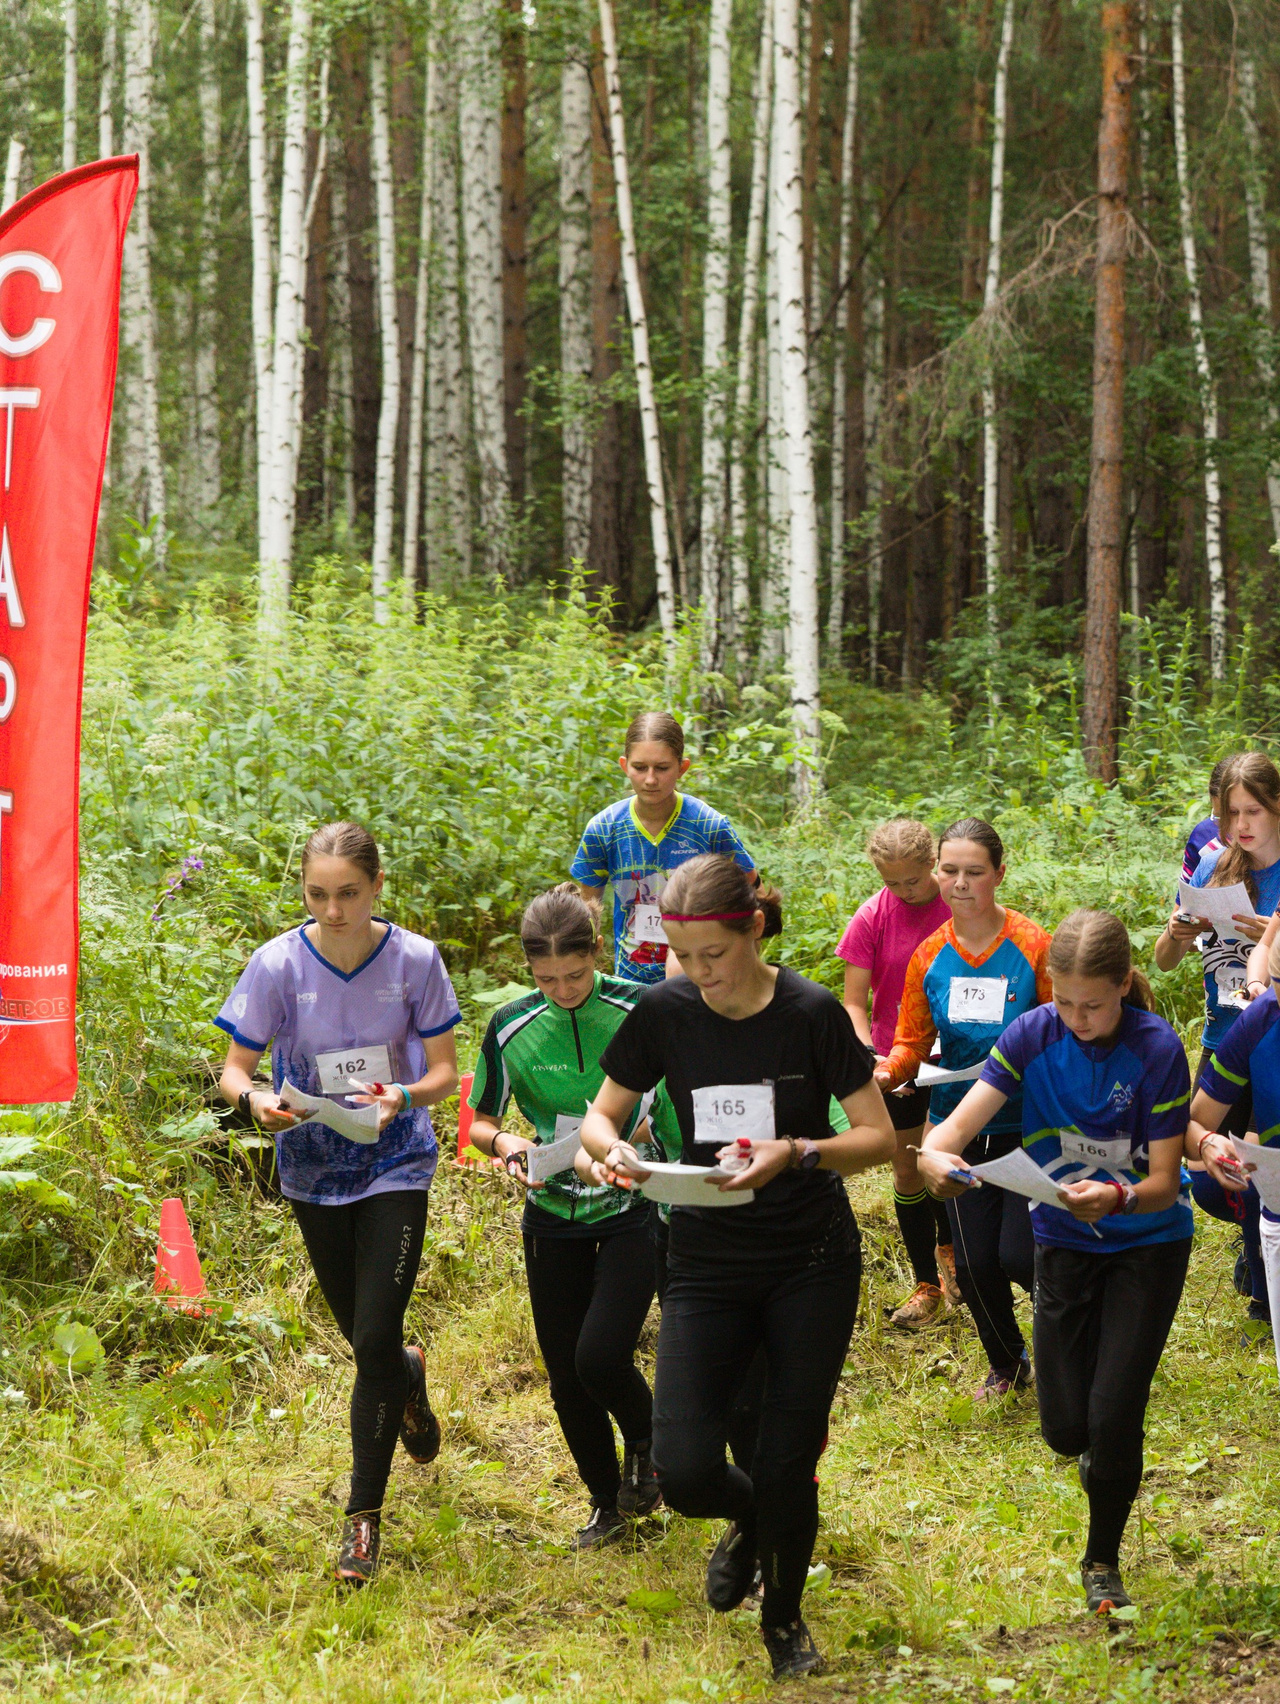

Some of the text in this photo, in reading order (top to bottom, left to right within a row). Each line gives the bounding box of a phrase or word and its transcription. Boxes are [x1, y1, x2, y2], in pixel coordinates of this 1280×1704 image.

[647, 915, 661, 926] 17
[0, 963, 68, 979] рования
[1231, 977, 1248, 988] 17
[963, 988, 985, 1000] 173
[335, 1058, 366, 1075] 162
[711, 1100, 746, 1115] 165
[1078, 1143, 1107, 1157] 166
[394, 1225, 412, 1285] ARSWEAR
